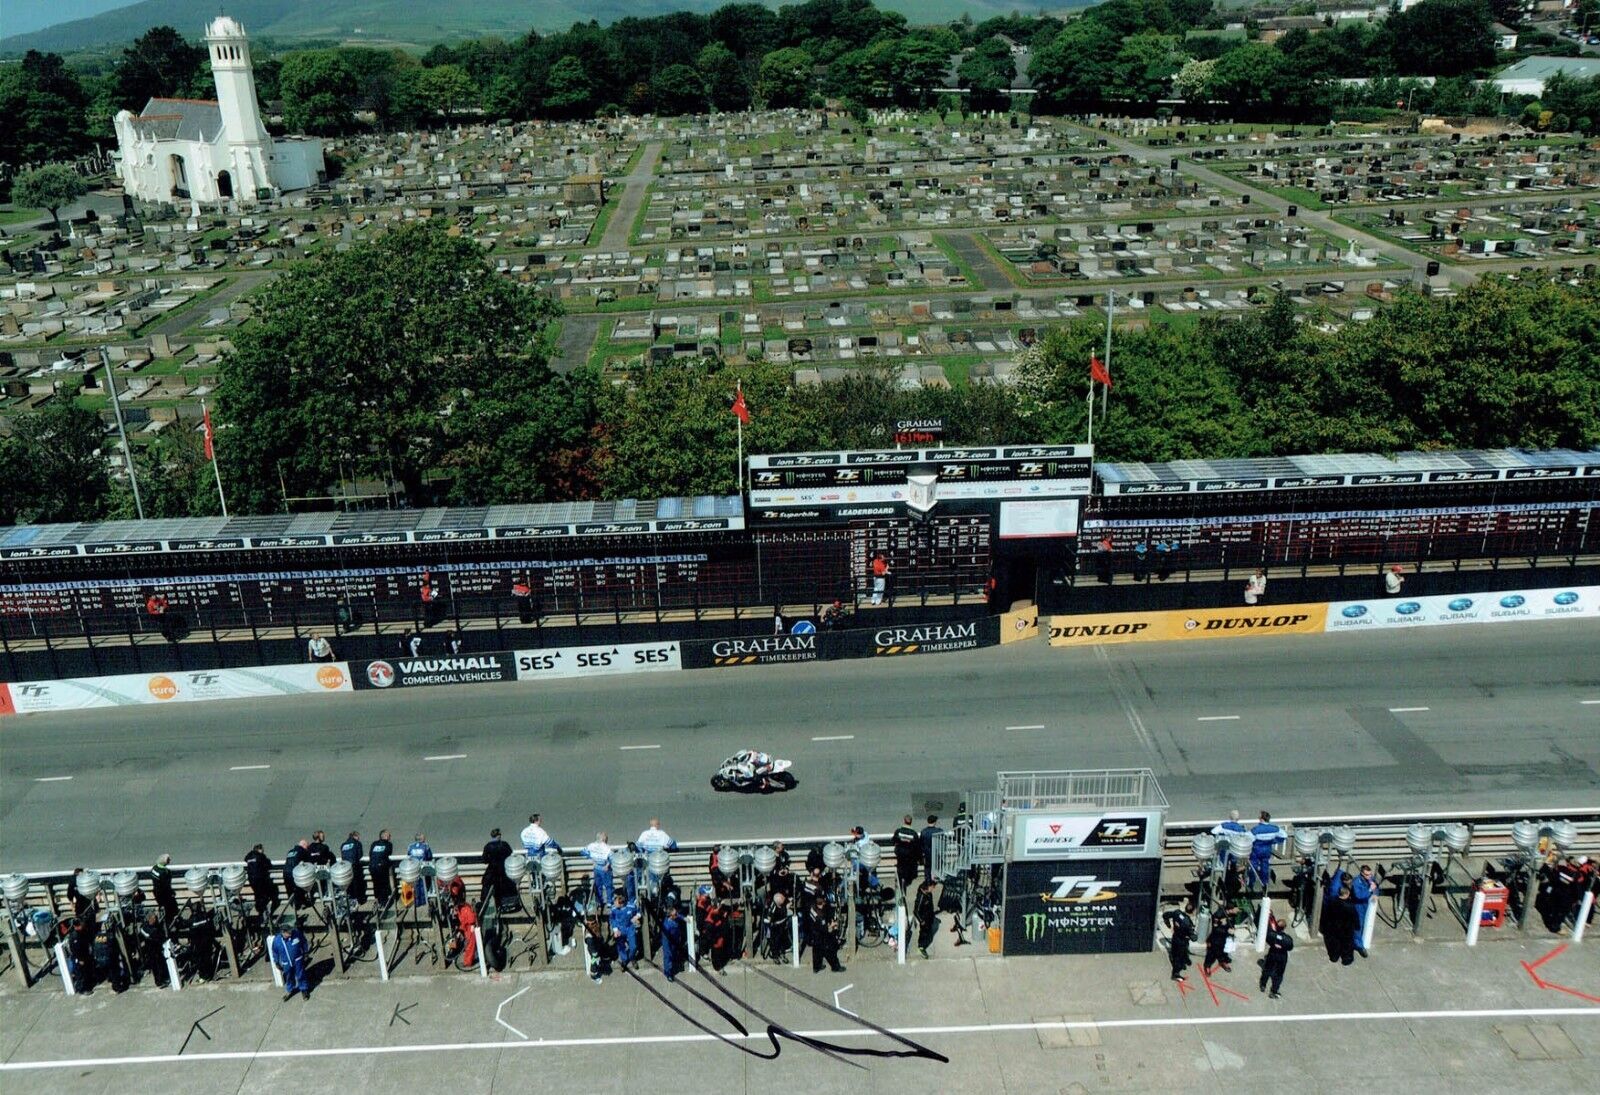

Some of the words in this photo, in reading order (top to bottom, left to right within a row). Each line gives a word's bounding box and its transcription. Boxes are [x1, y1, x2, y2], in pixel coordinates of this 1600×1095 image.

[897, 420, 942, 429] GRAHAM
[837, 507, 895, 516] LEADERBOARD
[1439, 612, 1478, 622] SUBARU
[1491, 609, 1530, 618] SUBARU
[1545, 606, 1584, 615] SUBARU
[1203, 615, 1311, 631] DUNLOP
[1333, 619, 1373, 627] SUBARU
[1386, 615, 1426, 625] SUBARU
[875, 622, 977, 646] GRAHAM
[712, 635, 816, 657] GRAHAM
[921, 639, 977, 651] TIMEKEEPERS
[399, 653, 501, 673] VAUXHALL
[520, 655, 555, 671] SES
[576, 652, 612, 668] SES
[634, 649, 668, 664] SES
[759, 651, 817, 662] TIMEKEEPERS
[188, 672, 220, 686] TT
[402, 672, 459, 686] COMMERCIAL
[460, 670, 502, 683] VEHICLES
[17, 684, 50, 697] TT
[1102, 823, 1140, 838] TT
[1050, 875, 1122, 904] TT
